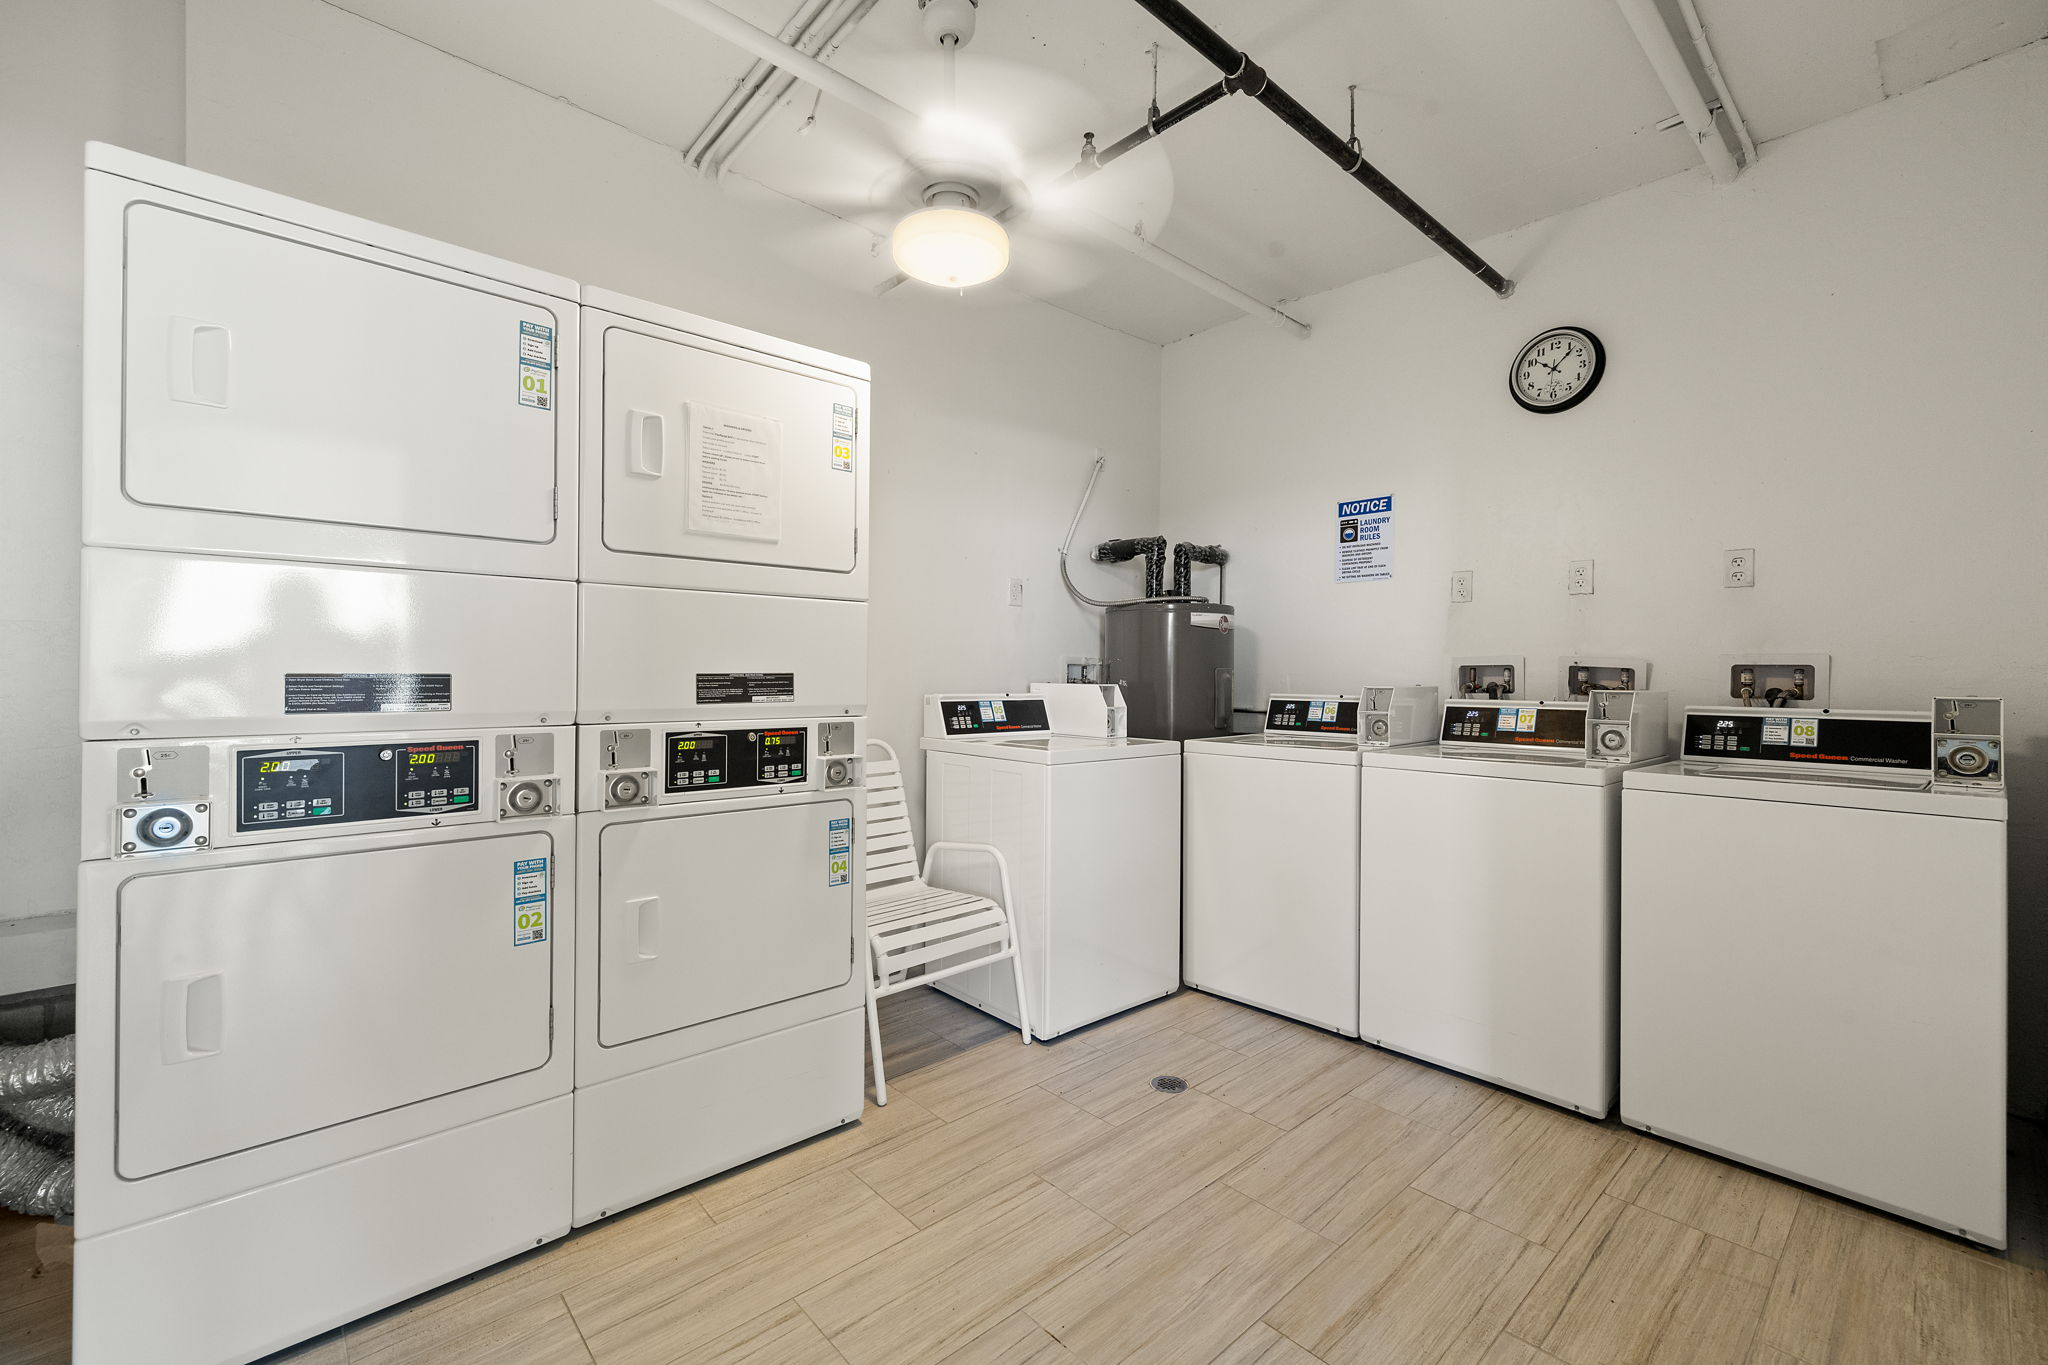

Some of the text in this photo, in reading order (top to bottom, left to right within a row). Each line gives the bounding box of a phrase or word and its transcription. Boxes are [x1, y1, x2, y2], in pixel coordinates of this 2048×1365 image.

[1550, 340, 1561, 350] 12
[1568, 342, 1571, 350] 1
[1537, 348, 1545, 357] 11
[1576, 348, 1582, 357] 2
[1528, 358, 1537, 368] 10
[1579, 360, 1586, 368] 3
[1523, 372, 1530, 380] 9
[522, 376, 548, 394] 01
[1528, 382, 1534, 390] 8
[1565, 382, 1572, 391] 5
[1537, 388, 1542, 397] 7
[1550, 390, 1557, 399] 6
[834, 445, 850, 460] 03
[1342, 499, 1388, 515] NOTICE
[1360, 516, 1390, 526] LAUNDRY
[1360, 533, 1380, 541] RULES
[1519, 714, 1534, 723] 07
[1794, 726, 1815, 736] 08
[678, 741, 696, 750] 2.00
[409, 754, 435, 764] 2.00
[260, 761, 290, 772] 2.00
[831, 860, 847, 874] 04
[518, 912, 542, 929] 02
